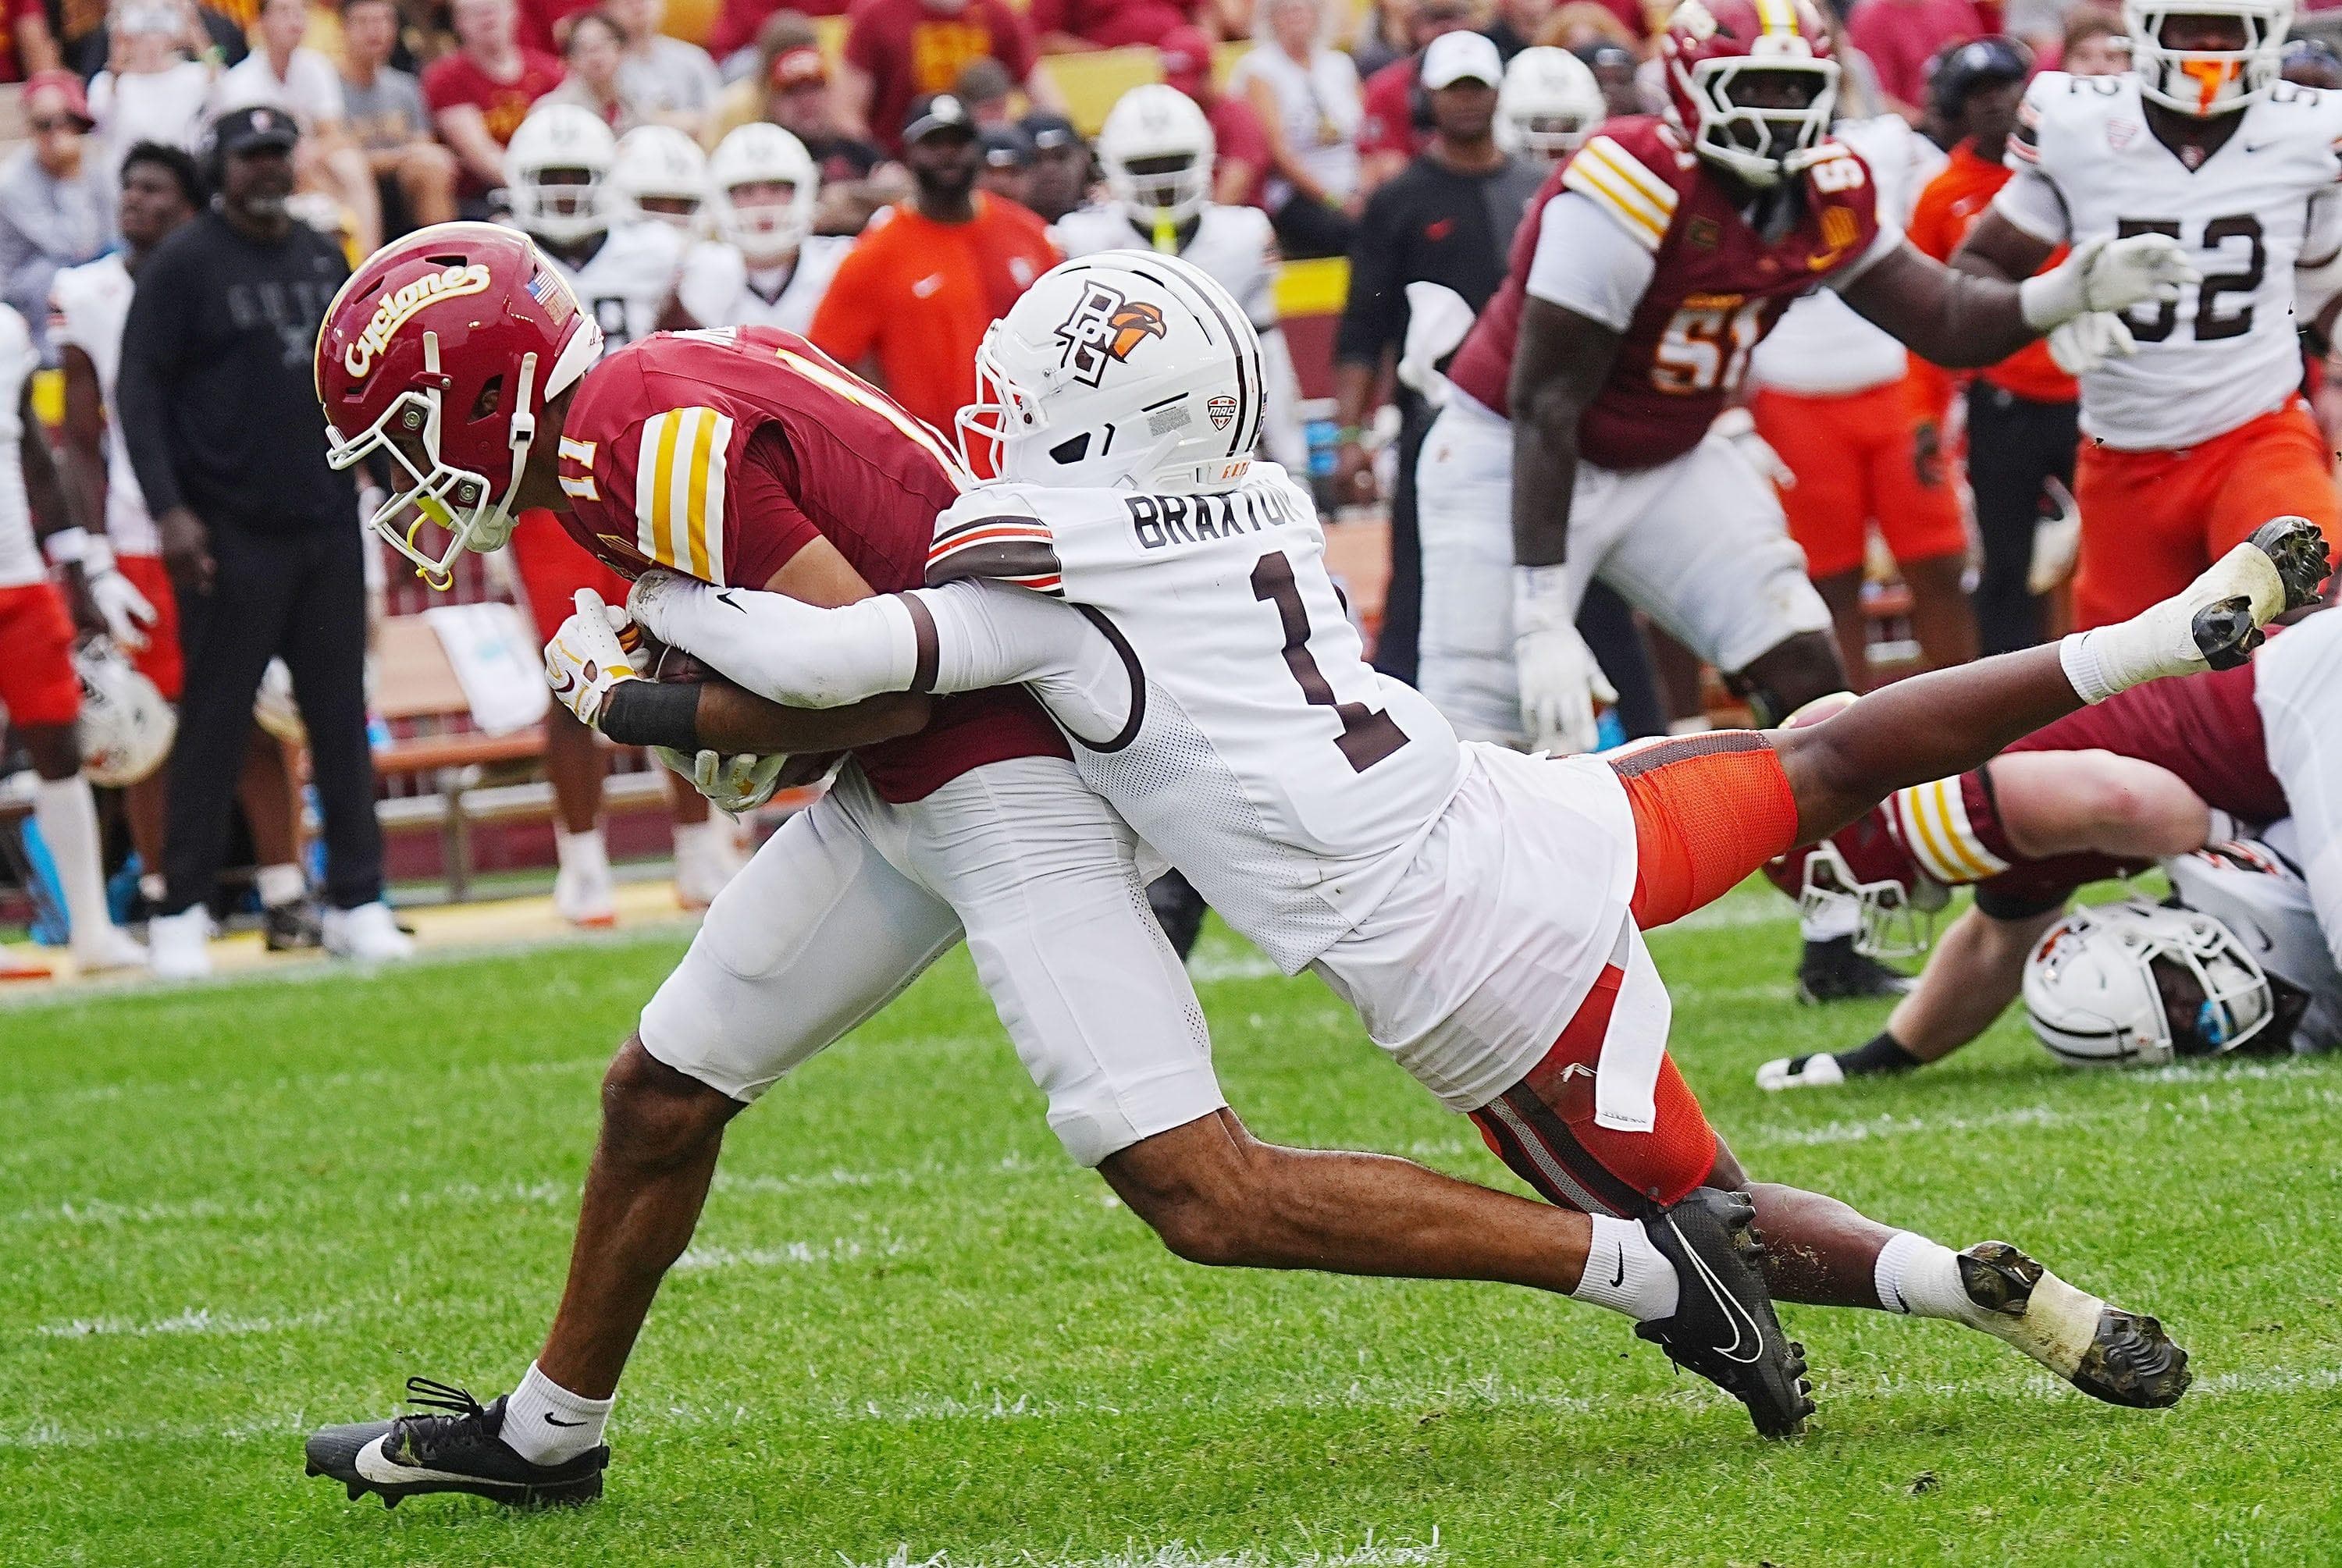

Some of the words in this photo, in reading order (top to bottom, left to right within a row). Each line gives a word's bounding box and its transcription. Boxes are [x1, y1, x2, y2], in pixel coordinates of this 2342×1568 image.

[344, 263, 491, 378] Cyclones
[1650, 298, 1766, 395] 51
[1210, 407, 1235, 416] MAC
[558, 435, 601, 502] 11
[1250, 549, 1411, 773] 1
